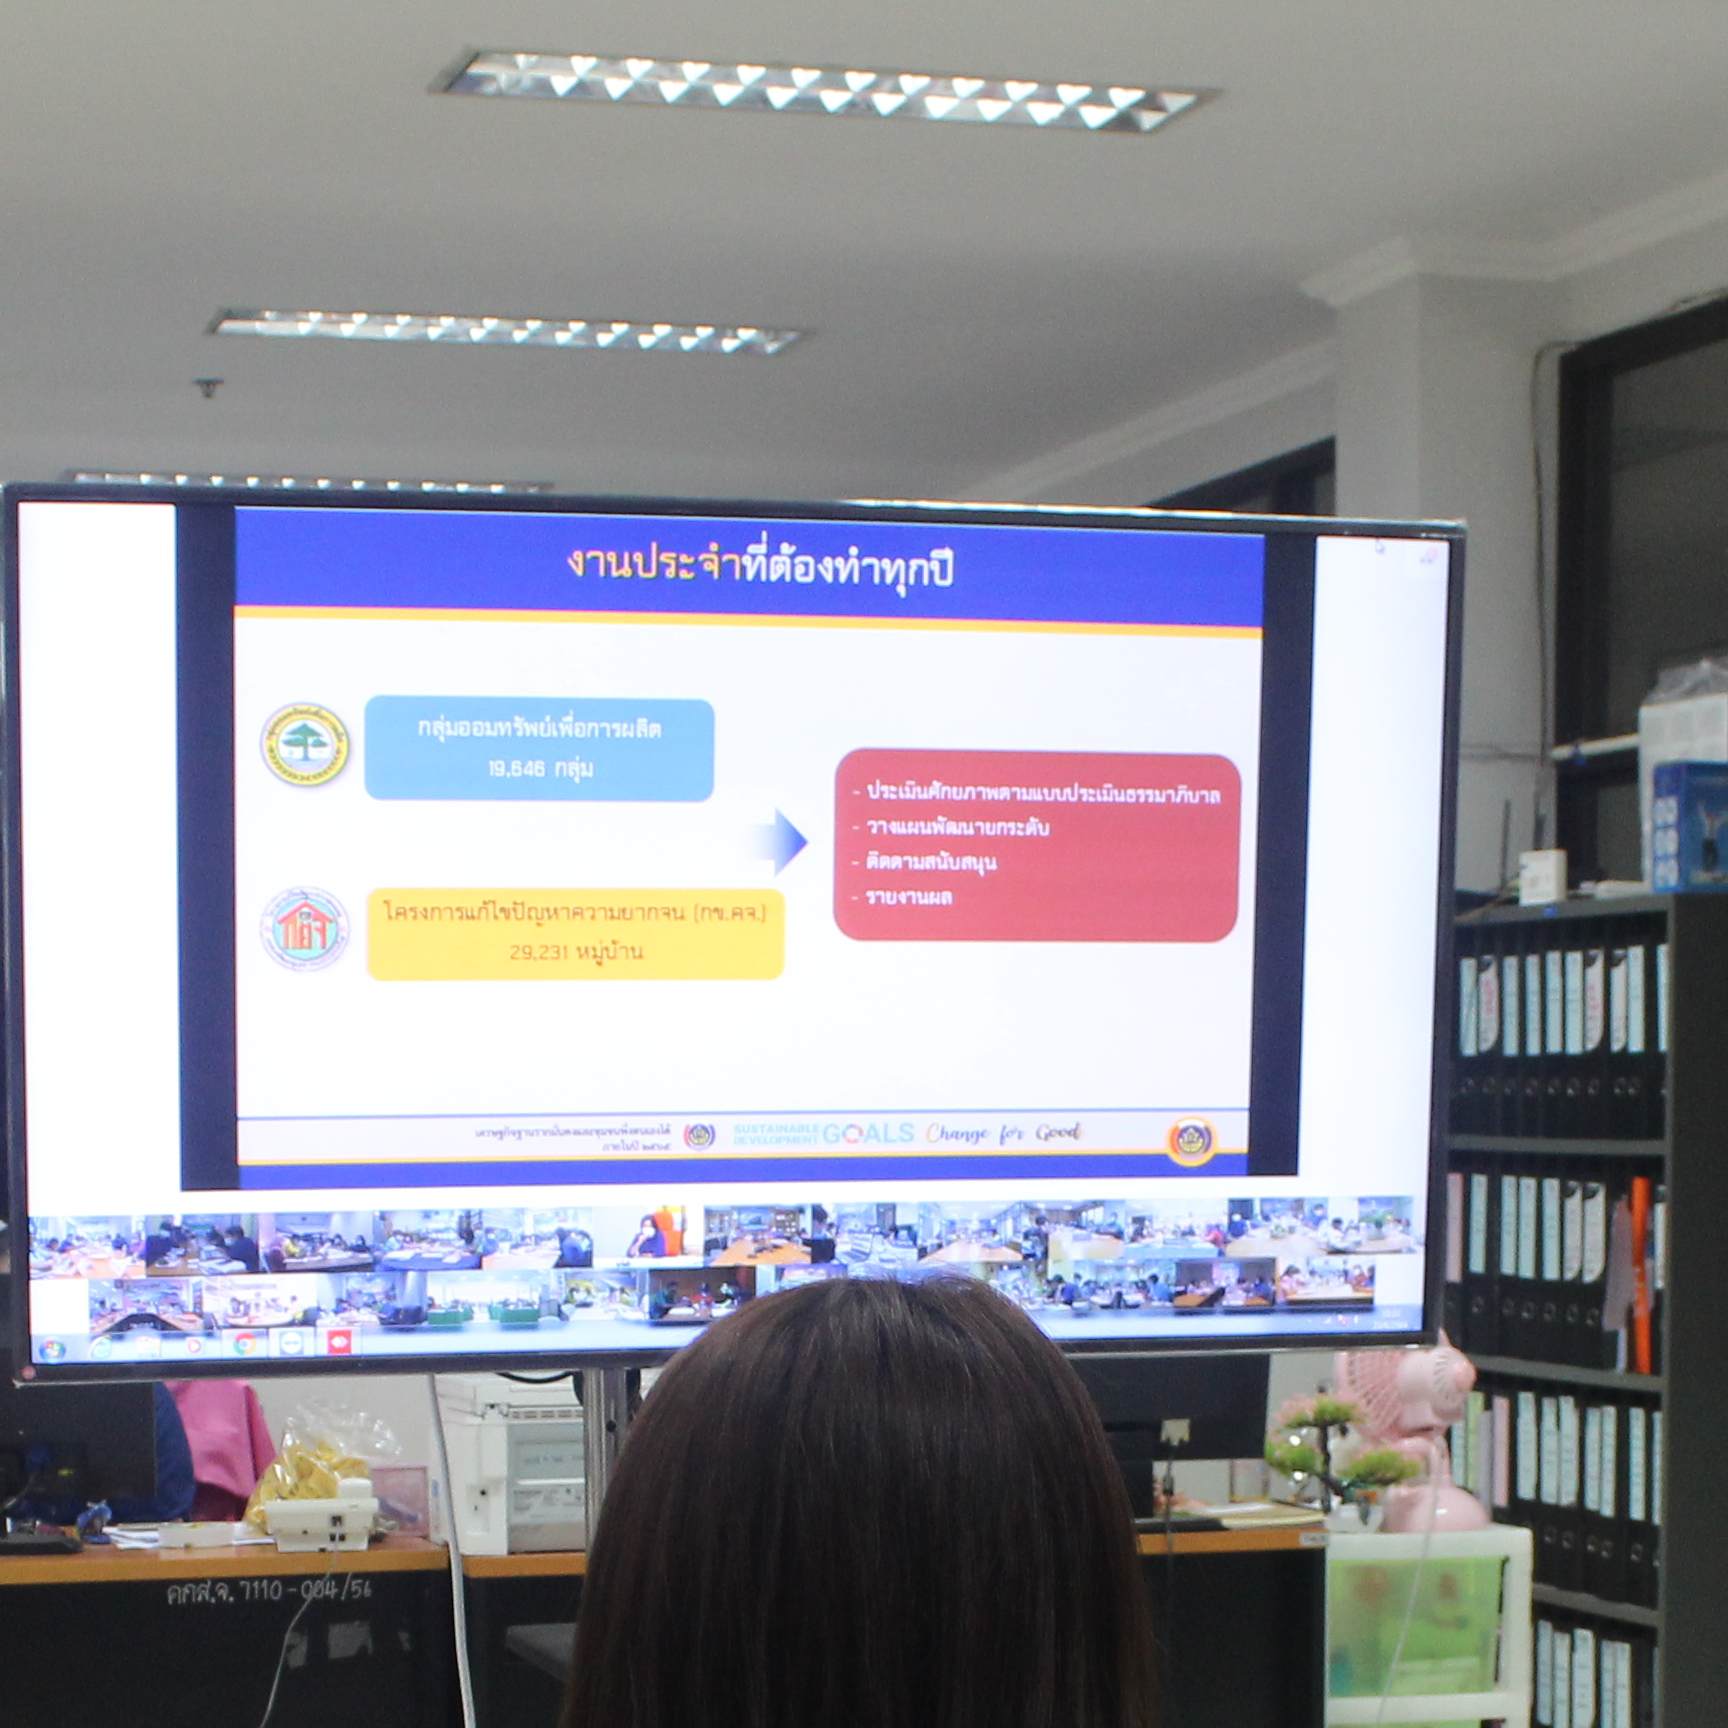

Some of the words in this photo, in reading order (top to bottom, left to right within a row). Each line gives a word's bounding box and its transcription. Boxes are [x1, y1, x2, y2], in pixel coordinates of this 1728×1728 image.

[567, 531, 955, 598] งานประจำที่ต้องทำทุกปี
[418, 711, 662, 743] กลุ่มออมทรัพย์เพื่อการผลิต
[487, 758, 547, 780] 19,646
[556, 759, 594, 784] กลุ่ม
[867, 815, 1051, 837] วางแผนพัฒนายกระดับ
[866, 850, 998, 876] ติดตามสนับสนุน
[866, 888, 953, 906] รายงานผล
[383, 899, 685, 927] โครงการแก้ไขปัญหาความยากจน
[510, 944, 569, 963] 29,231
[576, 939, 645, 967] หมู่บ้าน
[733, 1123, 819, 1134] SUSTAINABLE
[733, 1134, 819, 1145] DEVELOPMENT
[822, 1121, 915, 1144] GOALS
[925, 1121, 990, 1146] Change
[999, 1121, 1025, 1146] for
[1035, 1121, 1081, 1142] Good
